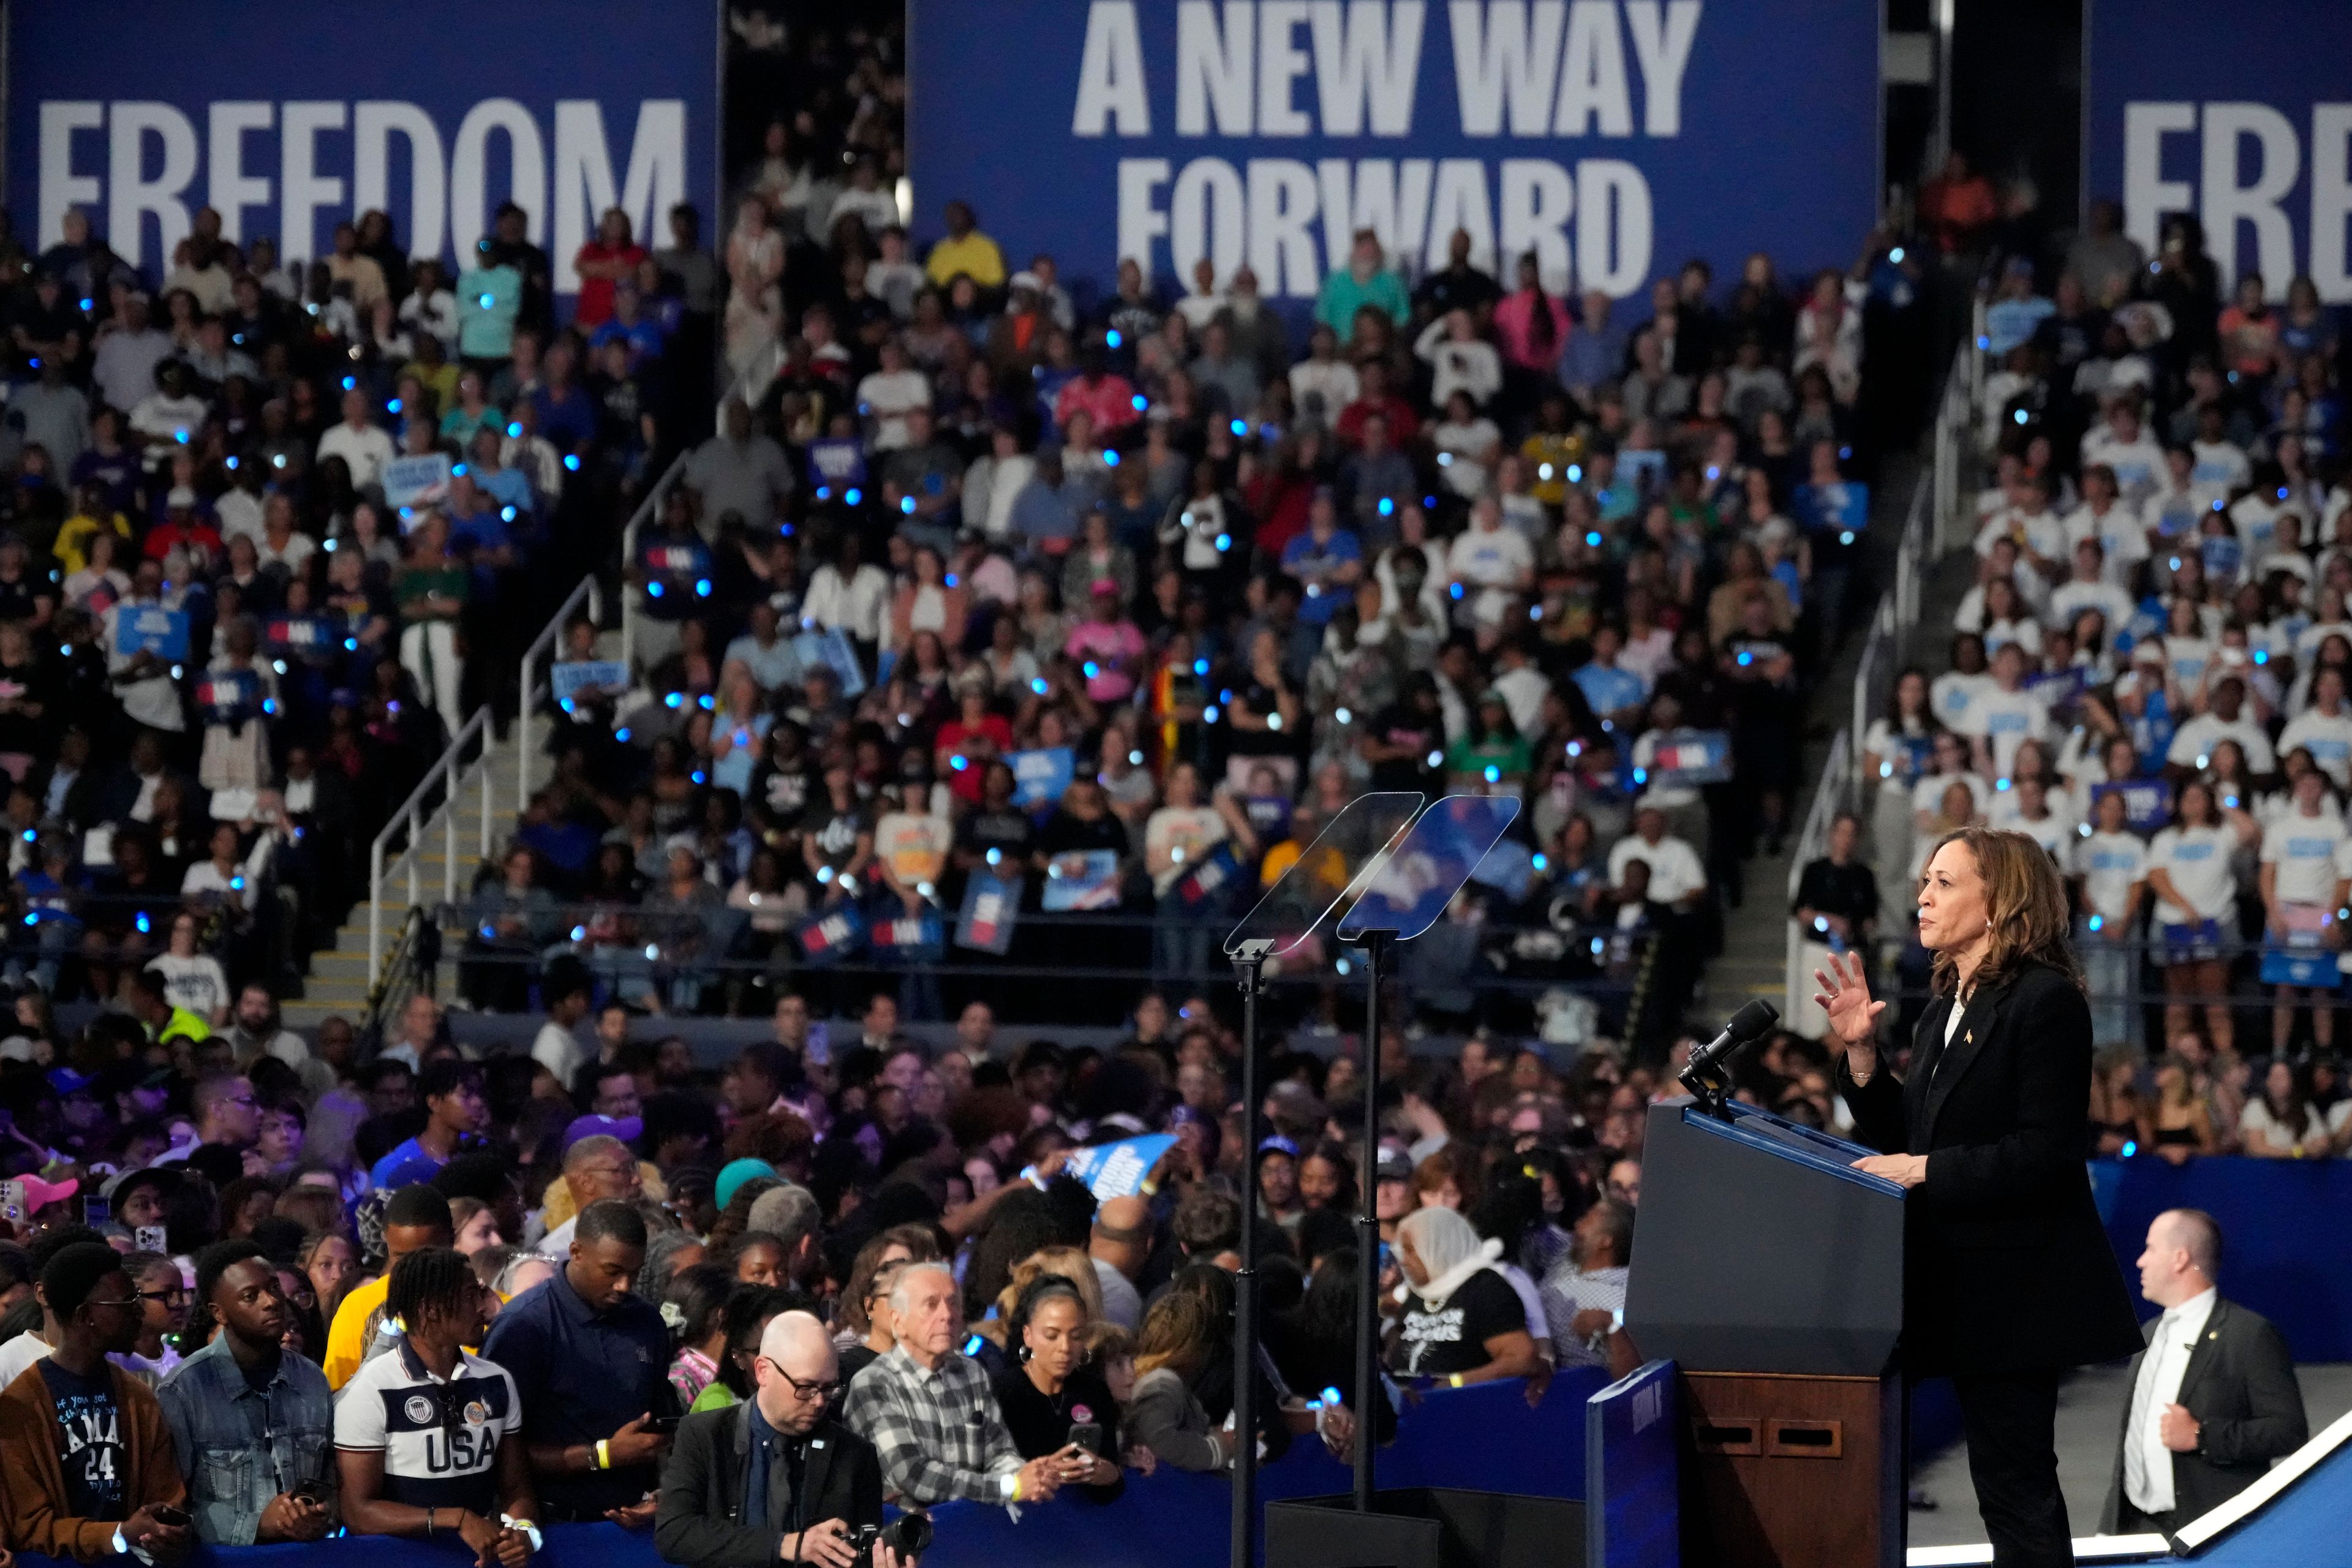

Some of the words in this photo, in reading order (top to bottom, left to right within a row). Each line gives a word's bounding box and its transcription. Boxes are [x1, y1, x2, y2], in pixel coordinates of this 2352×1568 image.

[1072, 0, 1151, 137] A
[1175, 0, 1427, 137] NEW
[1449, 0, 1702, 137] WAY
[37, 97, 687, 295] FREEDOM
[1117, 157, 1653, 299] FORWARD
[70, 1396, 88, 1408] you
[466, 1406, 484, 1419] Vote
[62, 1414, 124, 1461] AMA
[426, 1427, 495, 1473] USA
[85, 1447, 115, 1480] 24
